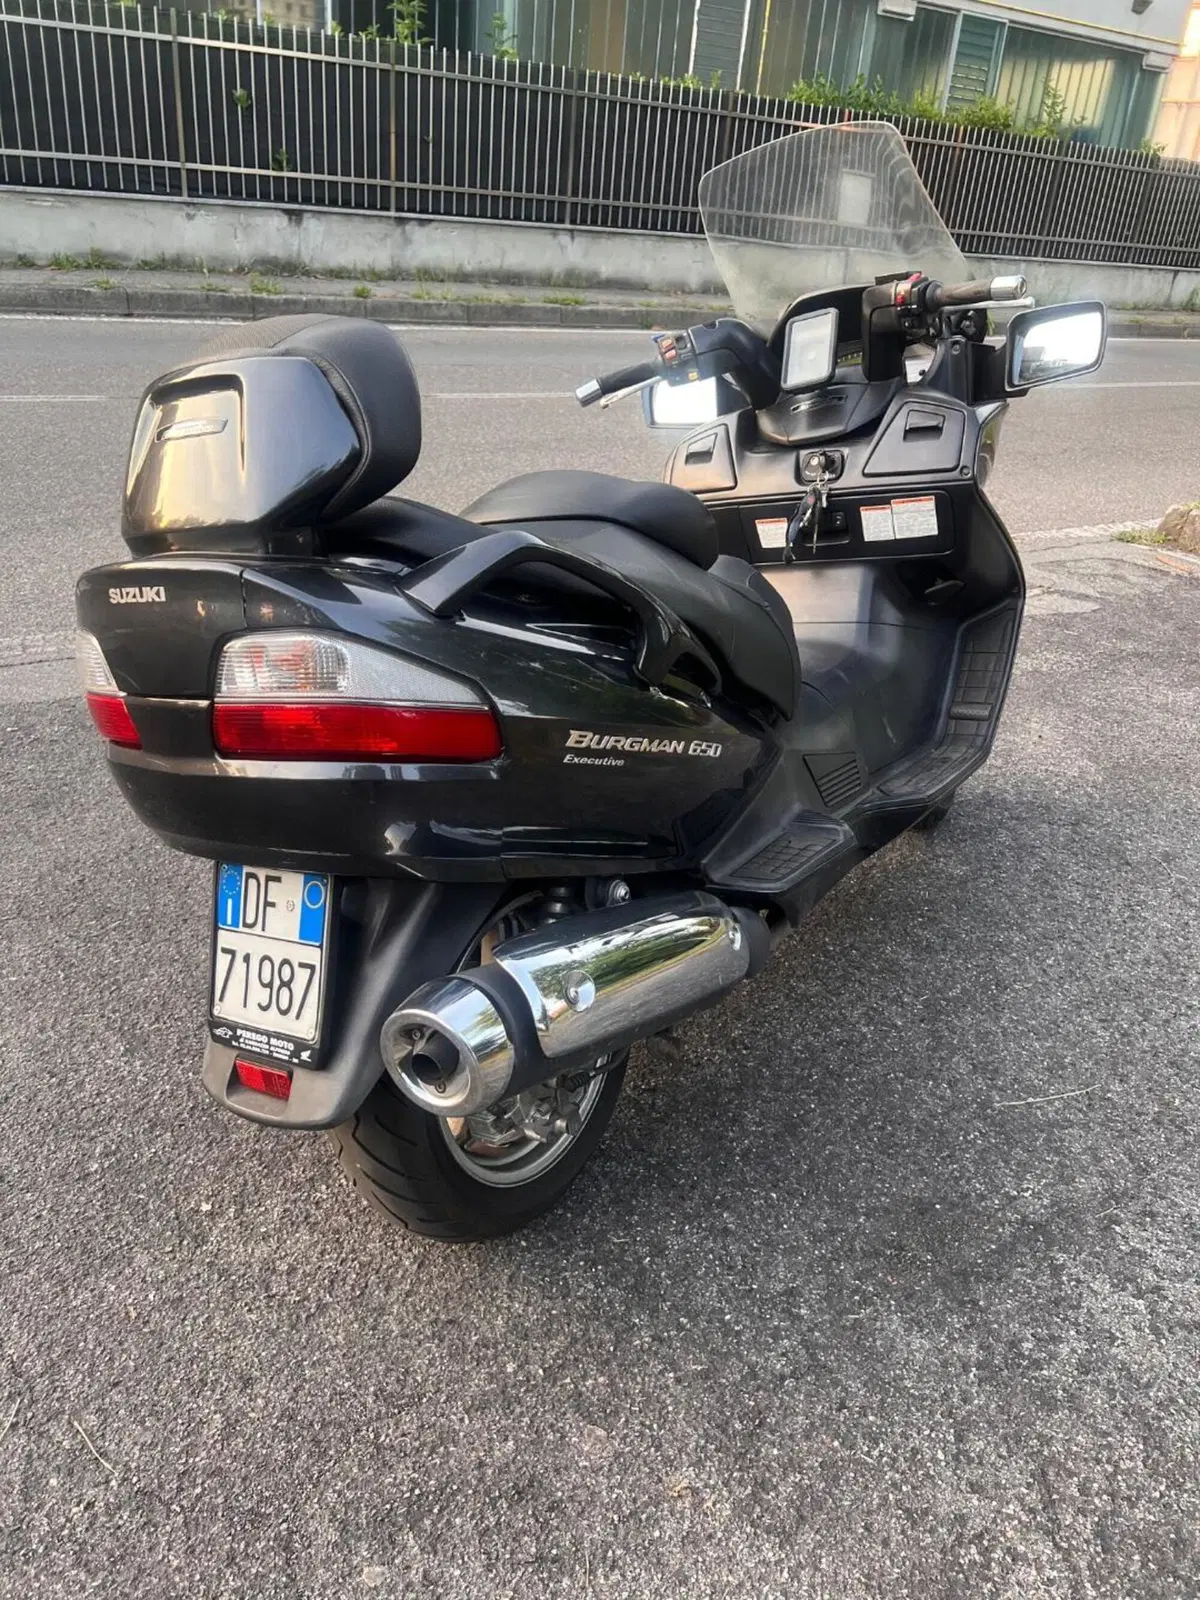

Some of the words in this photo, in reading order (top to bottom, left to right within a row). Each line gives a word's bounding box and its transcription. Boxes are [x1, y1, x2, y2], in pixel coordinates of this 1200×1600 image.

[108, 586, 166, 604] SUZUKI
[565, 729, 685, 754] BURGMAN
[688, 740, 722, 758] 650
[563, 754, 625, 767] Executive
[242, 871, 282, 932] DF
[218, 947, 316, 1020] 71987
[236, 1028, 268, 1044] PEREGO
[269, 1037, 295, 1051] MOTO
